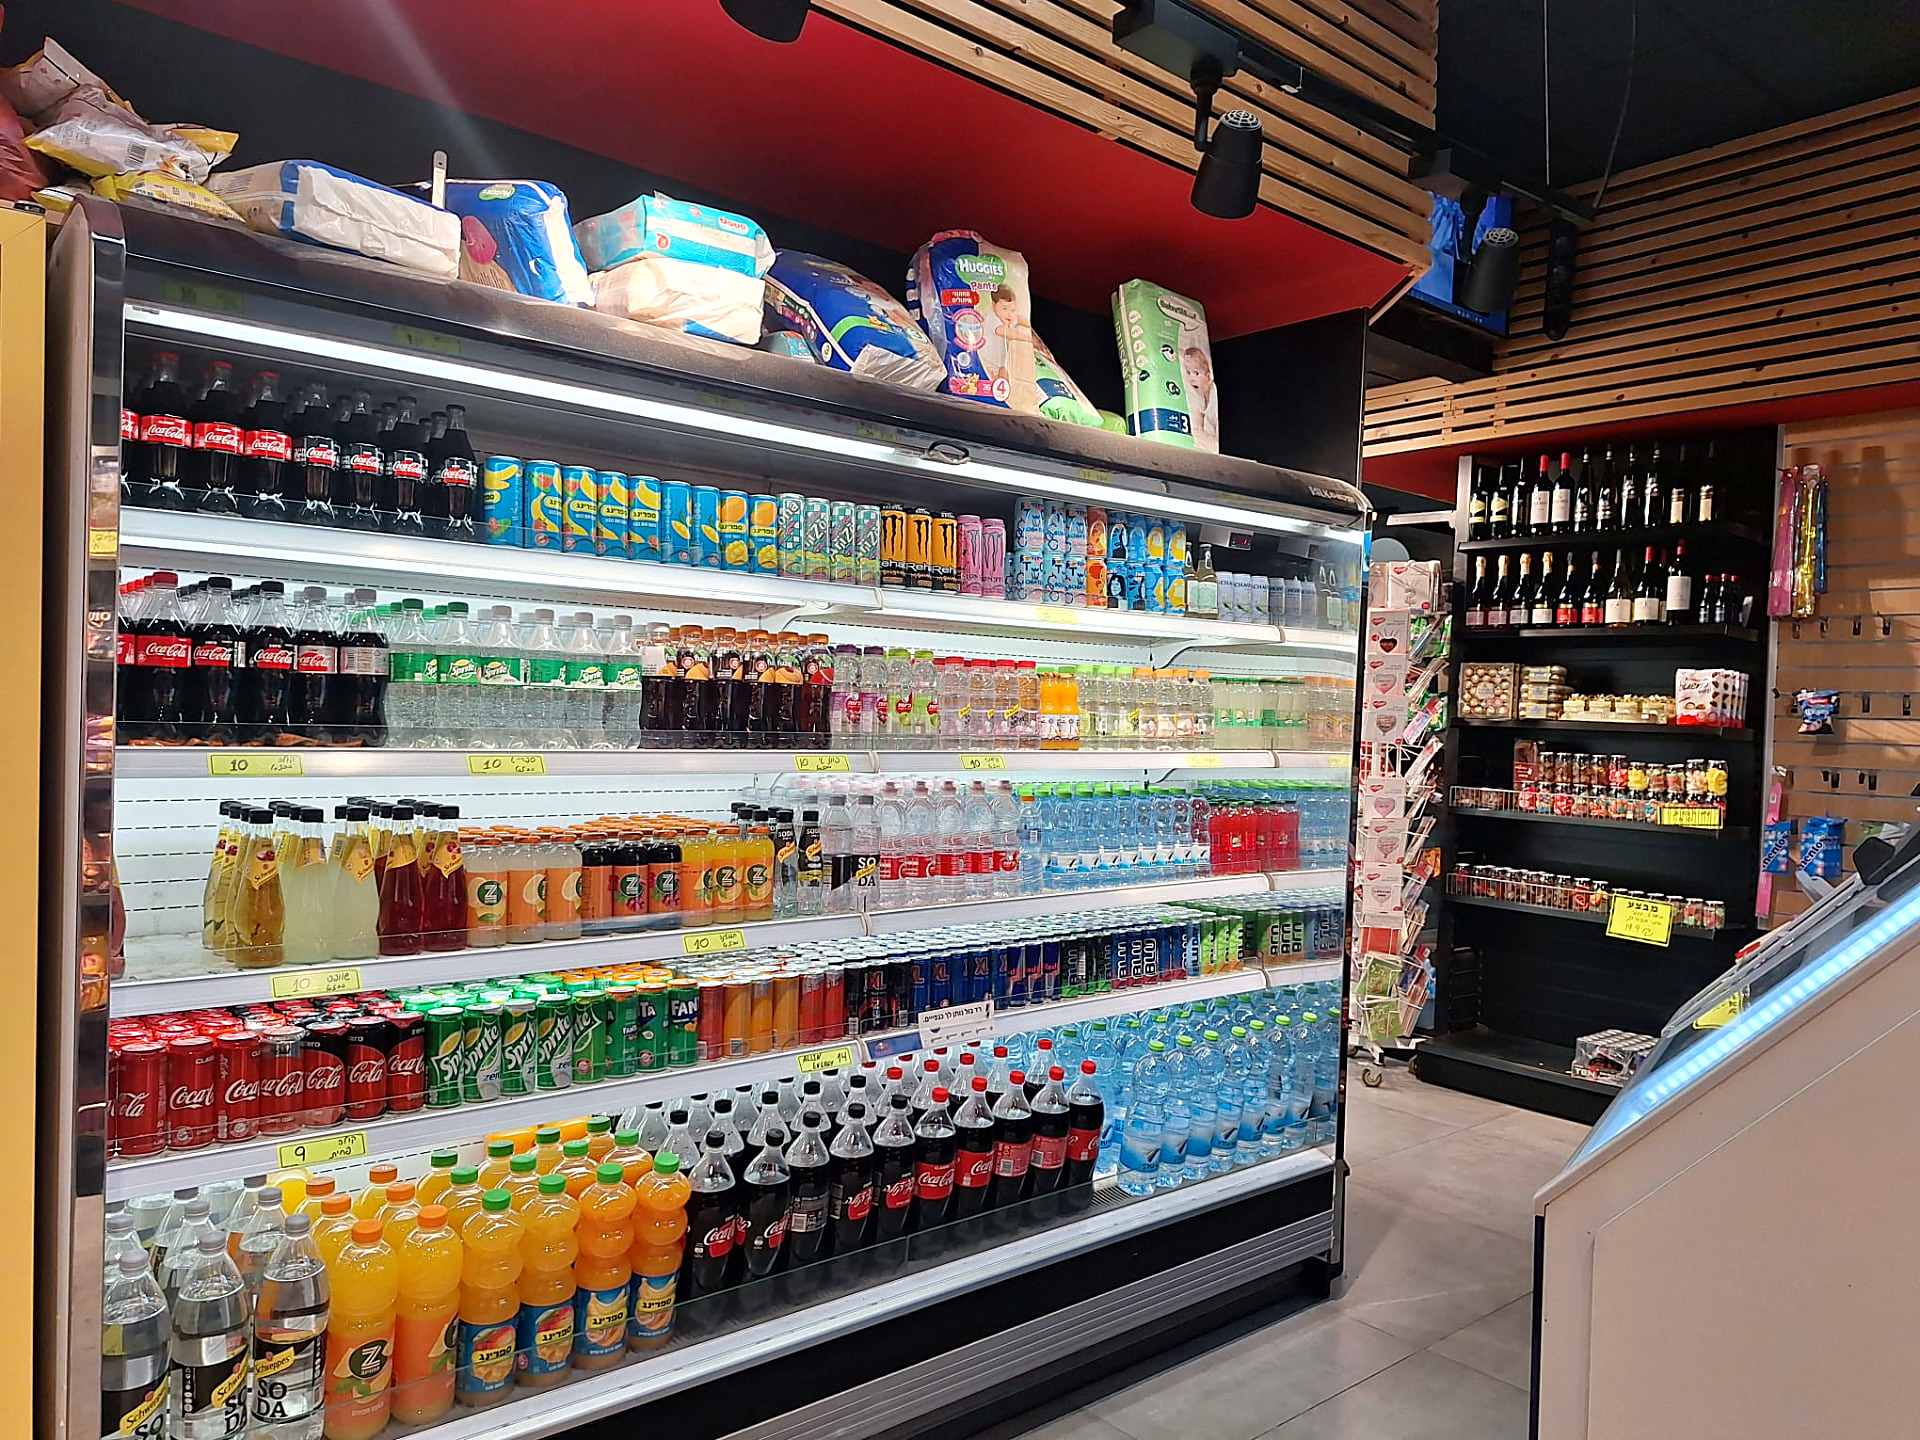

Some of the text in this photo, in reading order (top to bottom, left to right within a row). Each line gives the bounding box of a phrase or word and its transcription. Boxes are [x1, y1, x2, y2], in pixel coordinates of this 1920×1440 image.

[958, 259, 1003, 276] HUGGIES
[970, 281, 998, 292] Pants
[997, 380, 1006, 395] 4
[1181, 415, 1189, 433] 3
[148, 425, 185, 440] Coca-Cola
[205, 432, 239, 447] Coca-Cola
[252, 439, 286, 453] Coca-Cola
[146, 642, 187, 658] Coca-Cola
[193, 645, 232, 661] Coca-Cola
[254, 649, 293, 664] Coca-Cola
[299, 654, 330, 668] ca-Cola
[451, 664, 475, 677] Sprite
[484, 664, 509, 678] Sprite
[230, 759, 248, 771] 10
[483, 759, 501, 770] 10
[799, 757, 809, 768] 10
[970, 758, 981, 769] 10
[1762, 832, 1789, 870] mentos
[1799, 837, 1825, 871] mentos
[858, 857, 876, 869] SO
[858, 877, 876, 887] DA
[1628, 901, 1658, 913] מבצע
[694, 938, 709, 950] 10
[1131, 940, 1142, 978] BLU
[1143, 938, 1157, 977] BLU
[911, 965, 925, 983] L
[933, 962, 950, 981] XL
[292, 977, 310, 992] 10
[870, 971, 888, 991] XL
[671, 997, 699, 1016] FAN
[837, 1051, 848, 1064] 14
[294, 1146, 306, 1162] 9
[642, 1297, 672, 1309] ספרינג
[591, 1311, 624, 1325] ספרינג
[541, 1325, 572, 1341] ספרינג
[361, 1345, 381, 1367] Z
[478, 1346, 512, 1361] ספרינג
[257, 1380, 288, 1400] SO
[257, 1399, 288, 1418] DA
